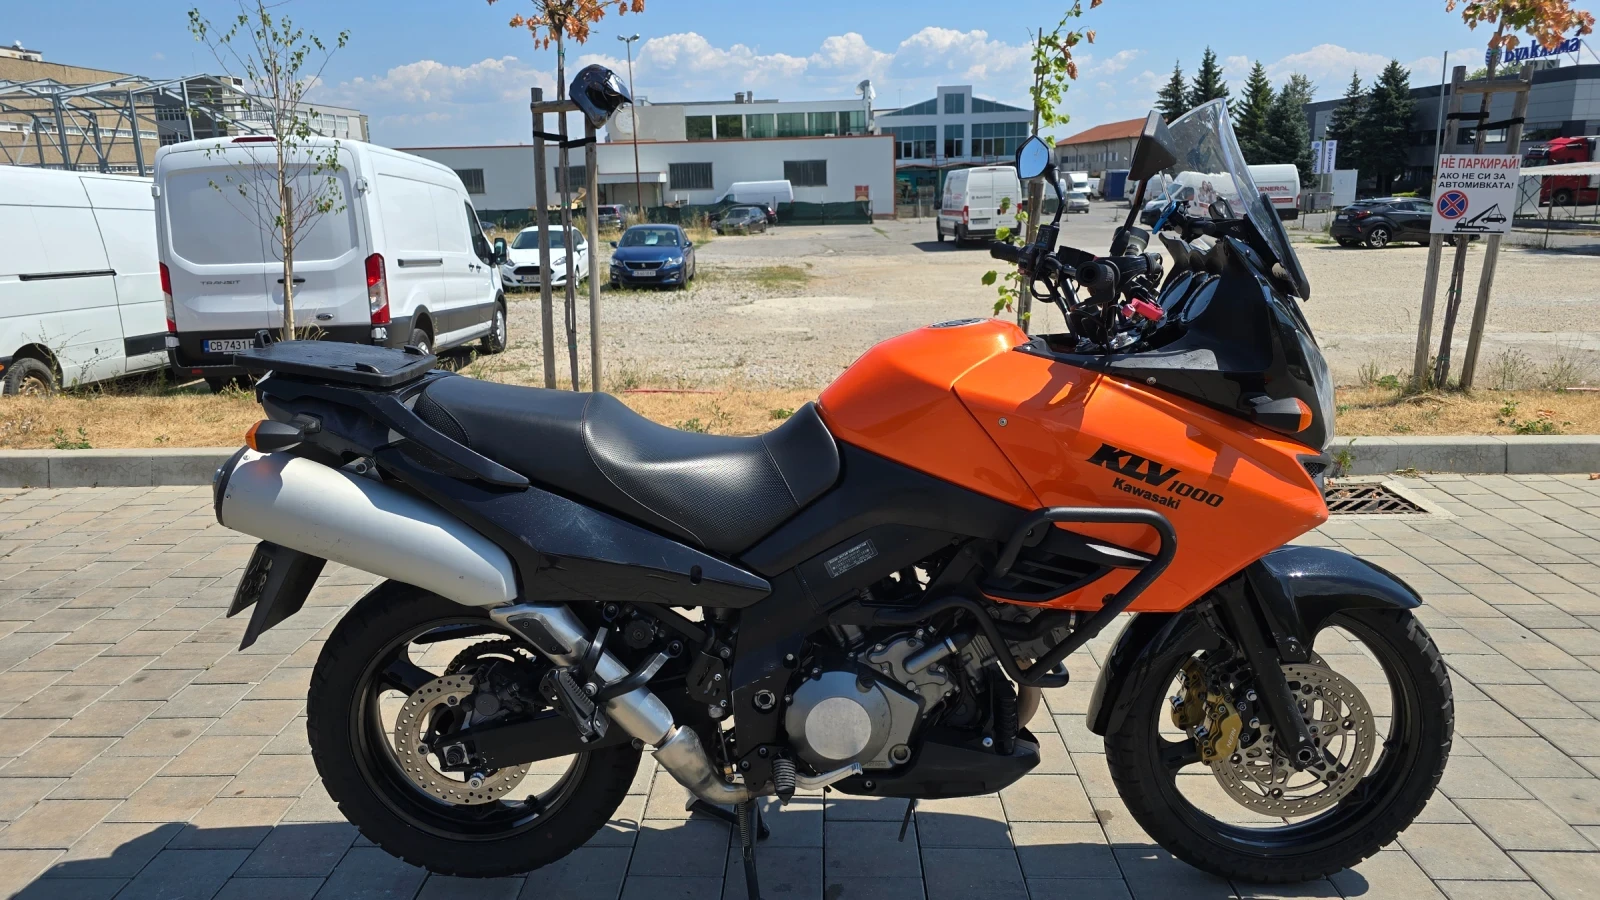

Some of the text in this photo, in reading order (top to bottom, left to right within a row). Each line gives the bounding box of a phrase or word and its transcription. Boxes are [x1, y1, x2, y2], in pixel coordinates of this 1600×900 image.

[1441, 156, 1520, 170] НЕ ПАРКИРАЙ!
[1440, 172, 1460, 180] АКО
[1438, 181, 1515, 189] АВТОМИВКАТА!
[1085, 443, 1224, 508] KLV 1000
[1112, 477, 1182, 510] Kawasaki
